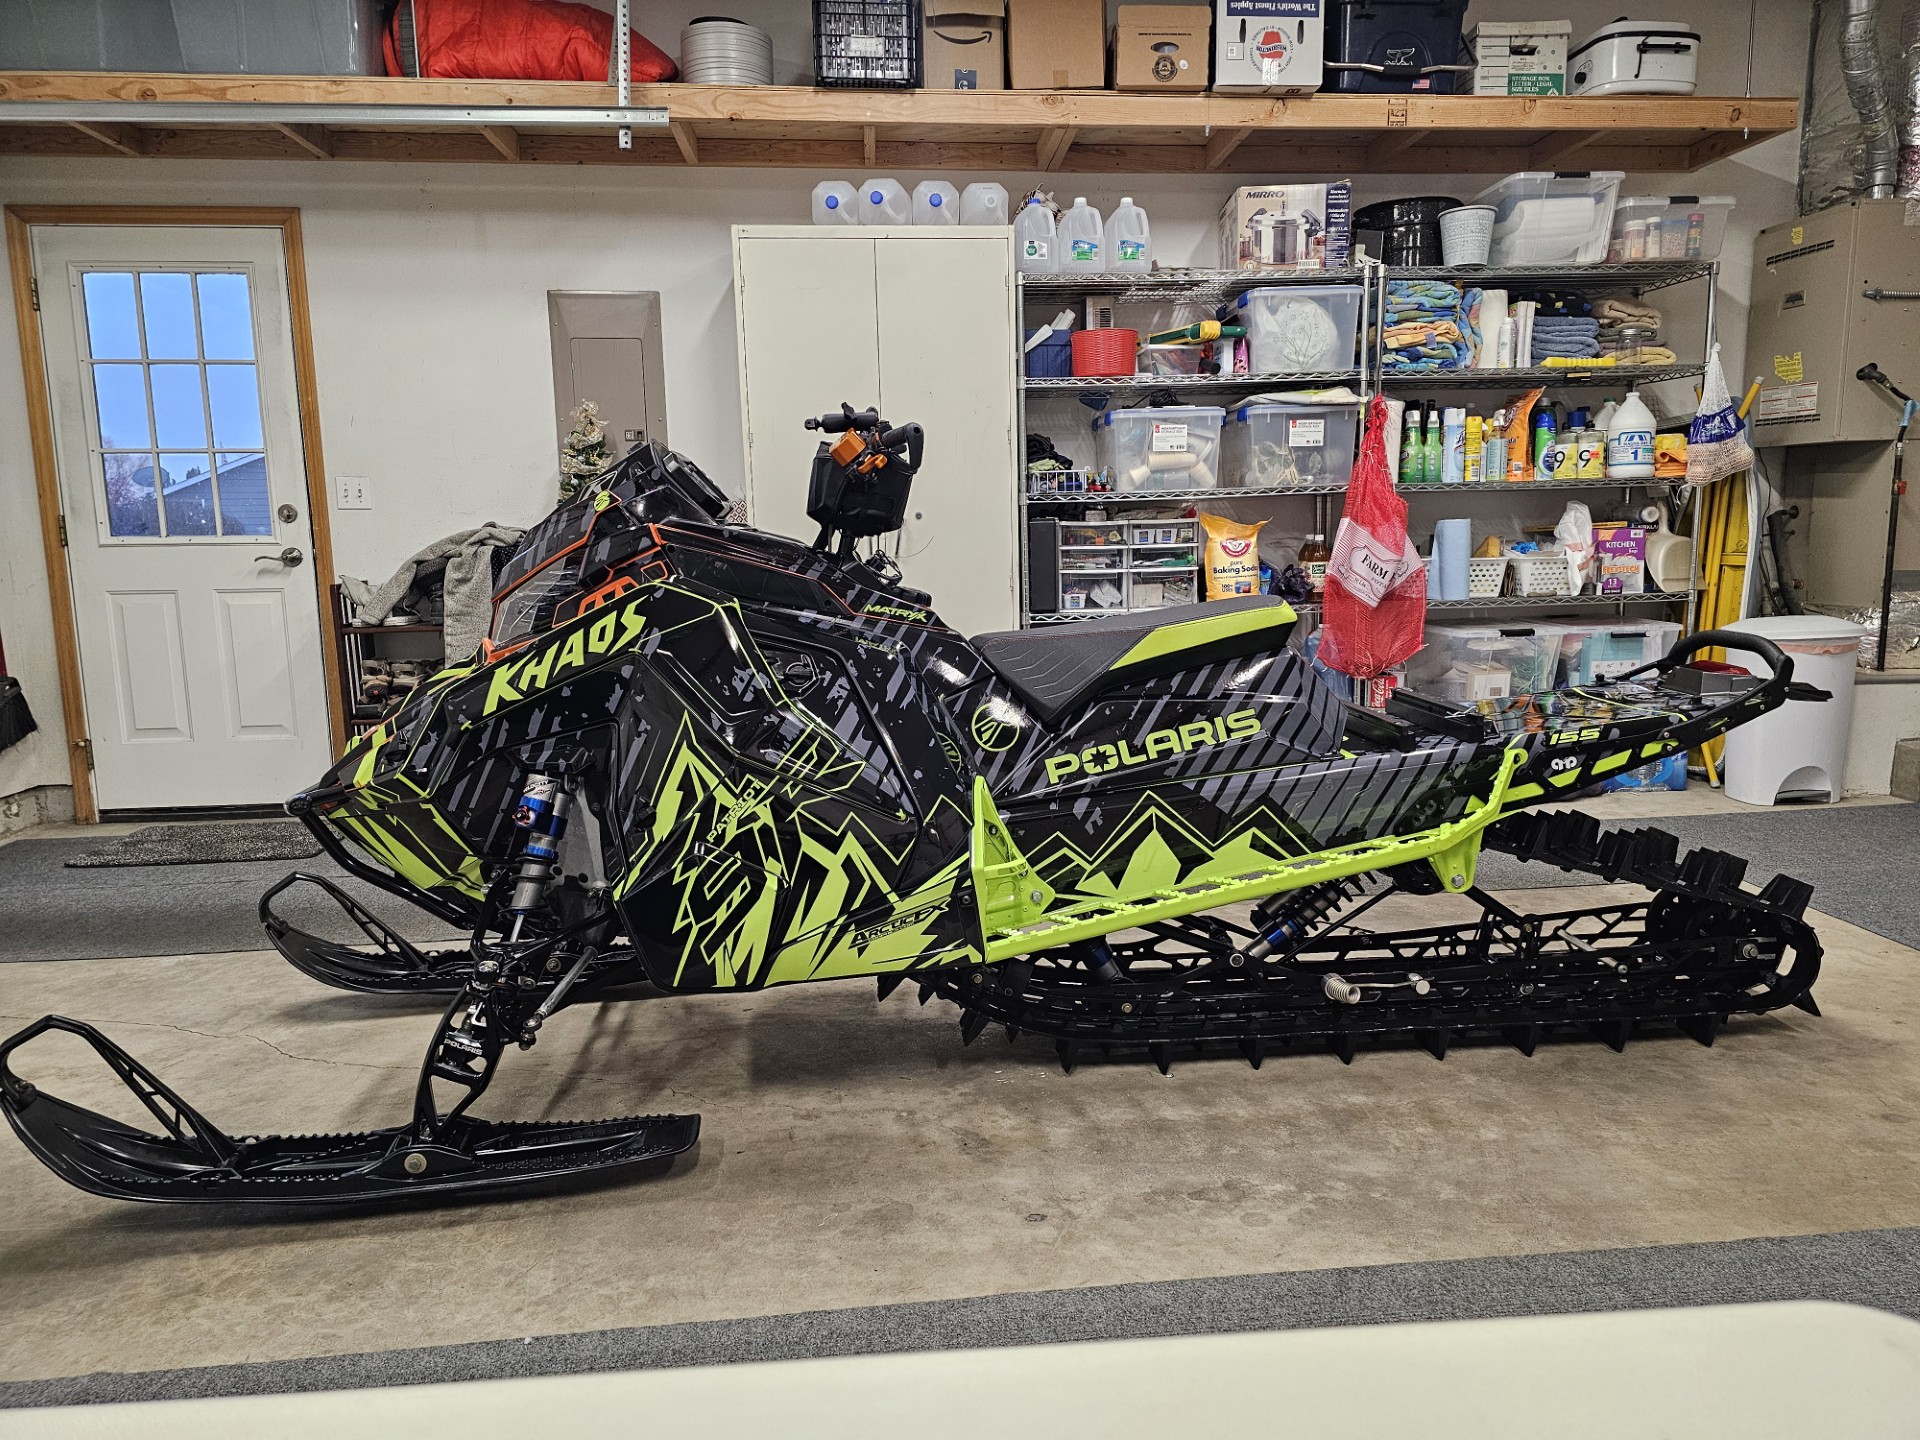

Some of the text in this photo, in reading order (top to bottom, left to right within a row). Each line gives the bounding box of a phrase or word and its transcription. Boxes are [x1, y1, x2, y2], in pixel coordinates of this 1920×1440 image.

[1230, 1, 1316, 11] The World's Finest Apples
[1555, 450, 1566, 469] 9
[1631, 449, 1639, 461] 1
[1213, 566, 1241, 574] Baking
[1361, 553, 1390, 580] FARM
[863, 604, 928, 623] MATRYX
[483, 594, 649, 716] KHAOS
[1044, 708, 1262, 784] POLARIS
[1549, 728, 1600, 745] 155
[705, 779, 763, 843] PATRIOT
[444, 1038, 483, 1056] POLARIS
